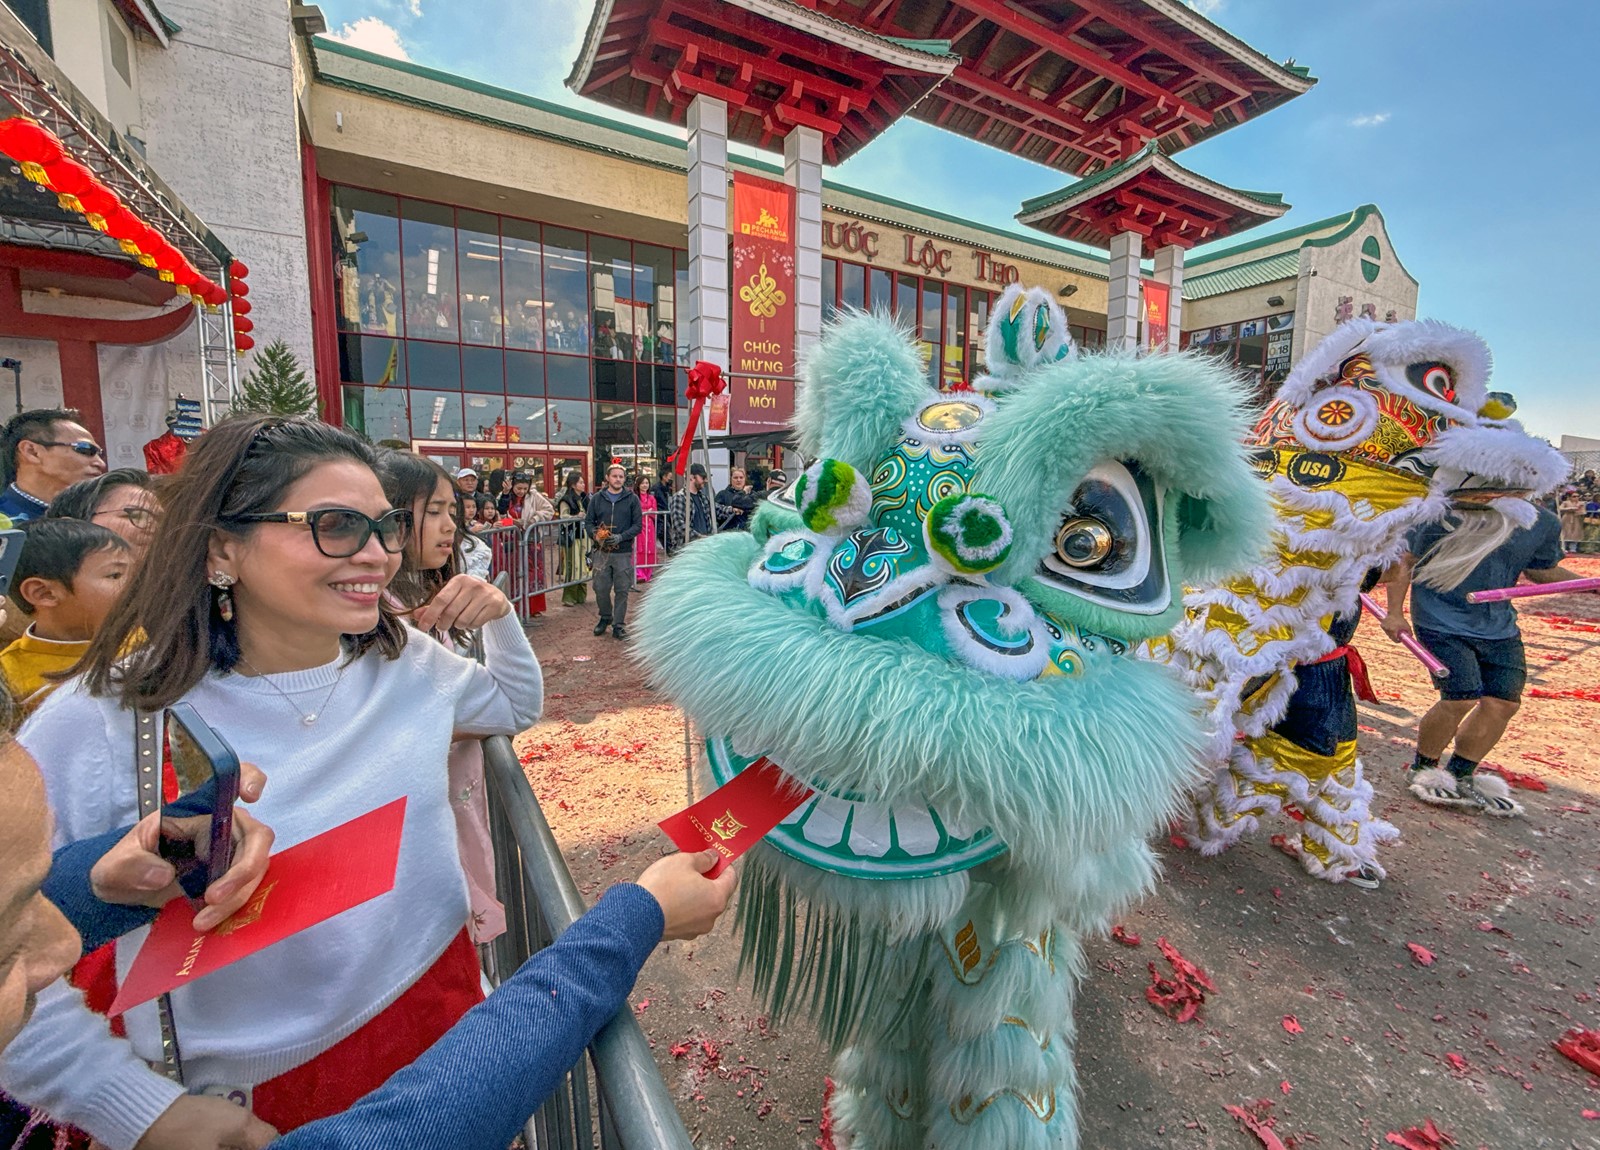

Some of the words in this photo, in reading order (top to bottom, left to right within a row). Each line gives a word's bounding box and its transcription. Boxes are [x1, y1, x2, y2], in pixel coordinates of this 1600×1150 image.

[751, 224, 787, 237] PECHANGA
[904, 234, 952, 274] LỘC
[743, 339, 781, 355] CHÚC
[1278, 345, 1289, 355] 18
[741, 357, 783, 373] MỪNG
[749, 393, 776, 409] MỚI
[1299, 460, 1331, 479] USA
[712, 842, 734, 858] ASIAN
[175, 935, 206, 976] ASIAN
